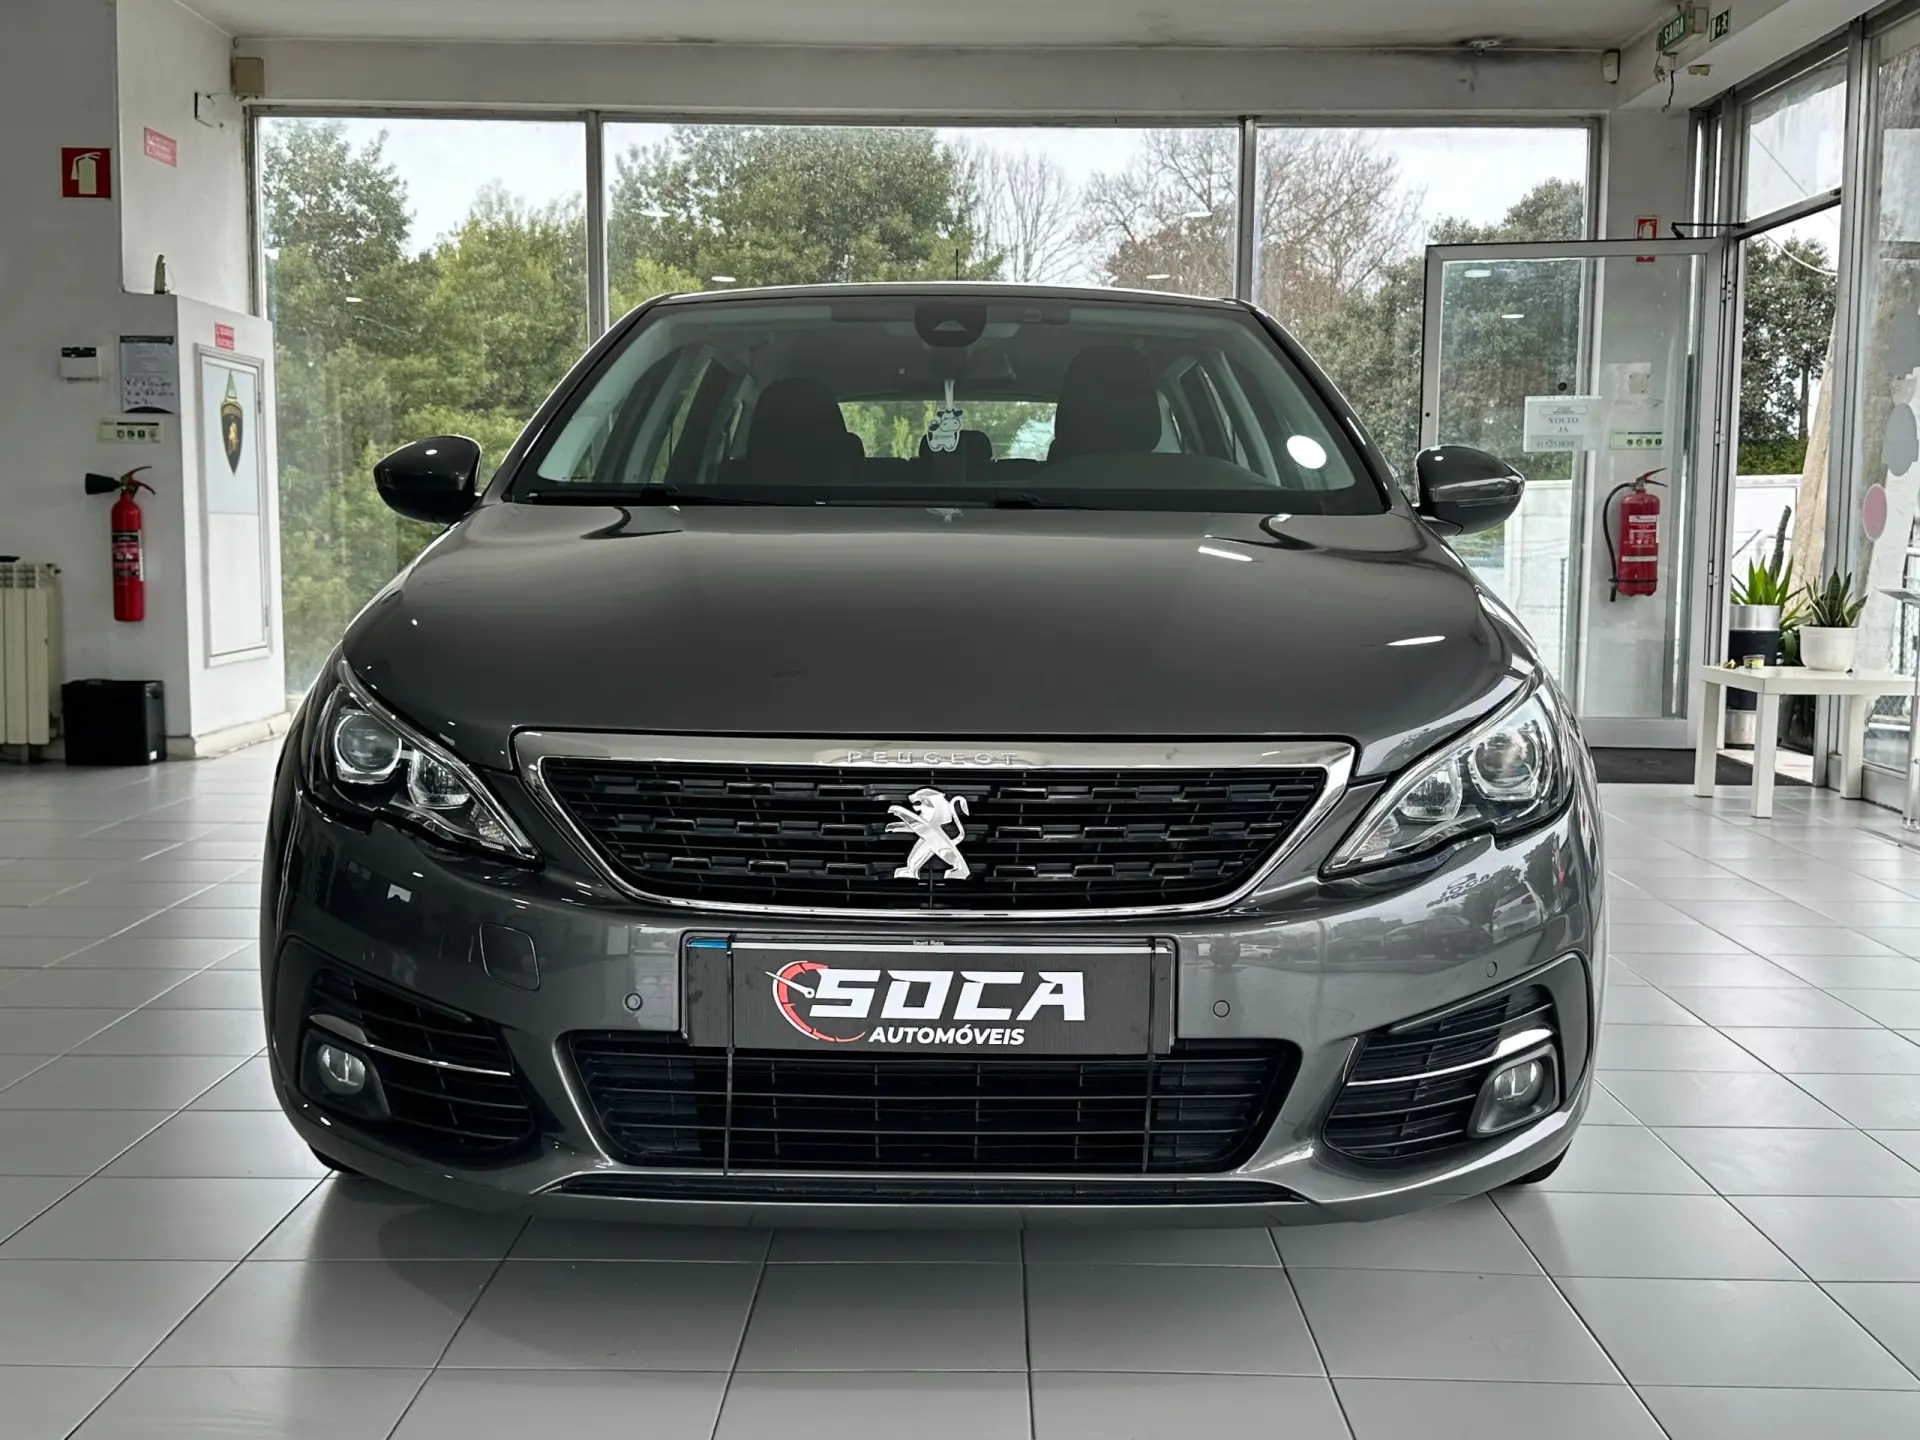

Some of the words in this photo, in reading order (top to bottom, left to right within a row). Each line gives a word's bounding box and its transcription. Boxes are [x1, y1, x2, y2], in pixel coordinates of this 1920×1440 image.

[847, 751, 1017, 766] PEUGEOT
[808, 968, 1086, 1021] SOCA
[868, 1024, 1026, 1046] AUTOMÓVEIS
